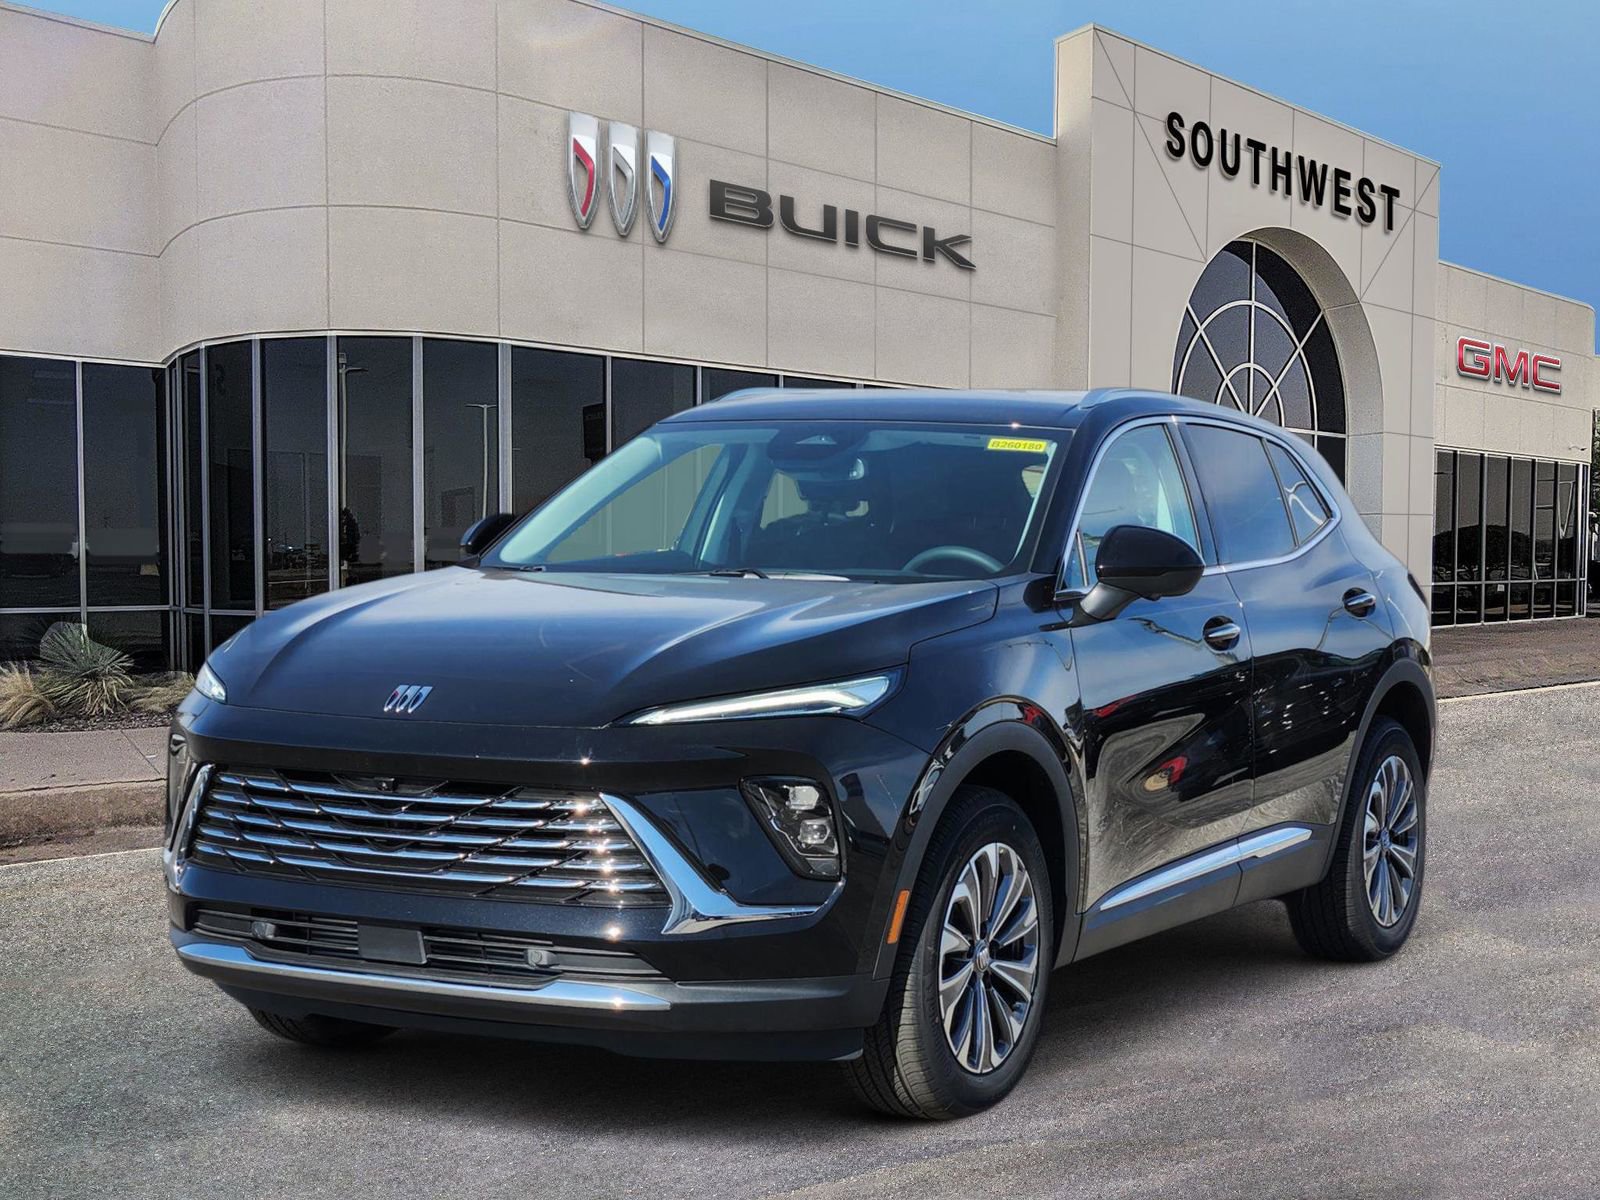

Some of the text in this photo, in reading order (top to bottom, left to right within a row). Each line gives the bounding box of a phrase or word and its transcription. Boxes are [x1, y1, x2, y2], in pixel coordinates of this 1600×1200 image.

[1165, 111, 1400, 232] SOUTHWEST
[709, 178, 976, 270] BUICK
[1457, 336, 1561, 393] GMC
